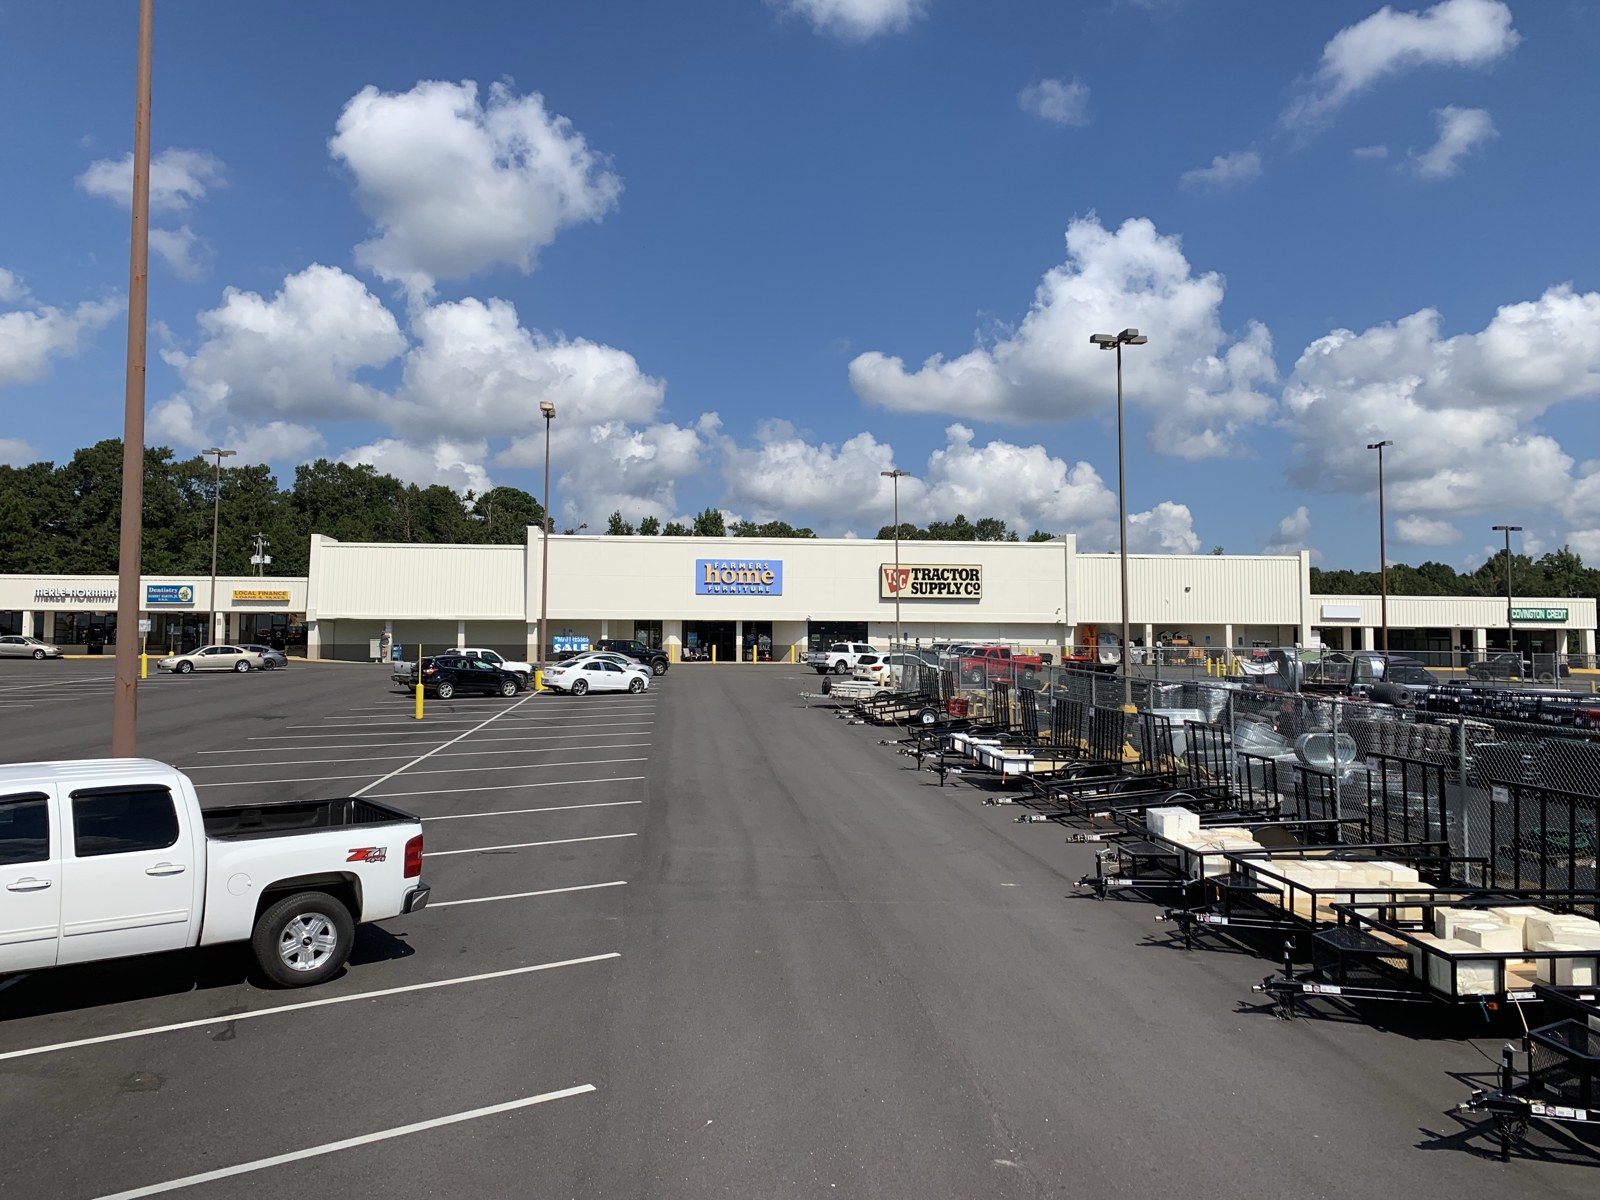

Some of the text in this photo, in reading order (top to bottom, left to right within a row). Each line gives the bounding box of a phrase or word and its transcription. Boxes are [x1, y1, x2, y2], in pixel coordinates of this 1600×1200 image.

[714, 562, 769, 570] FARMERS
[704, 563, 775, 585] home
[911, 568, 980, 581] TRACTOR
[35, 588, 117, 597] MERLE NORMAN
[149, 586, 179, 594] Dentistry
[708, 585, 771, 593] FURNITURE
[911, 582, 963, 595] SUPPLY
[1511, 609, 1567, 619] COVINGTON CREDIT
[553, 643, 589, 653] SALE
